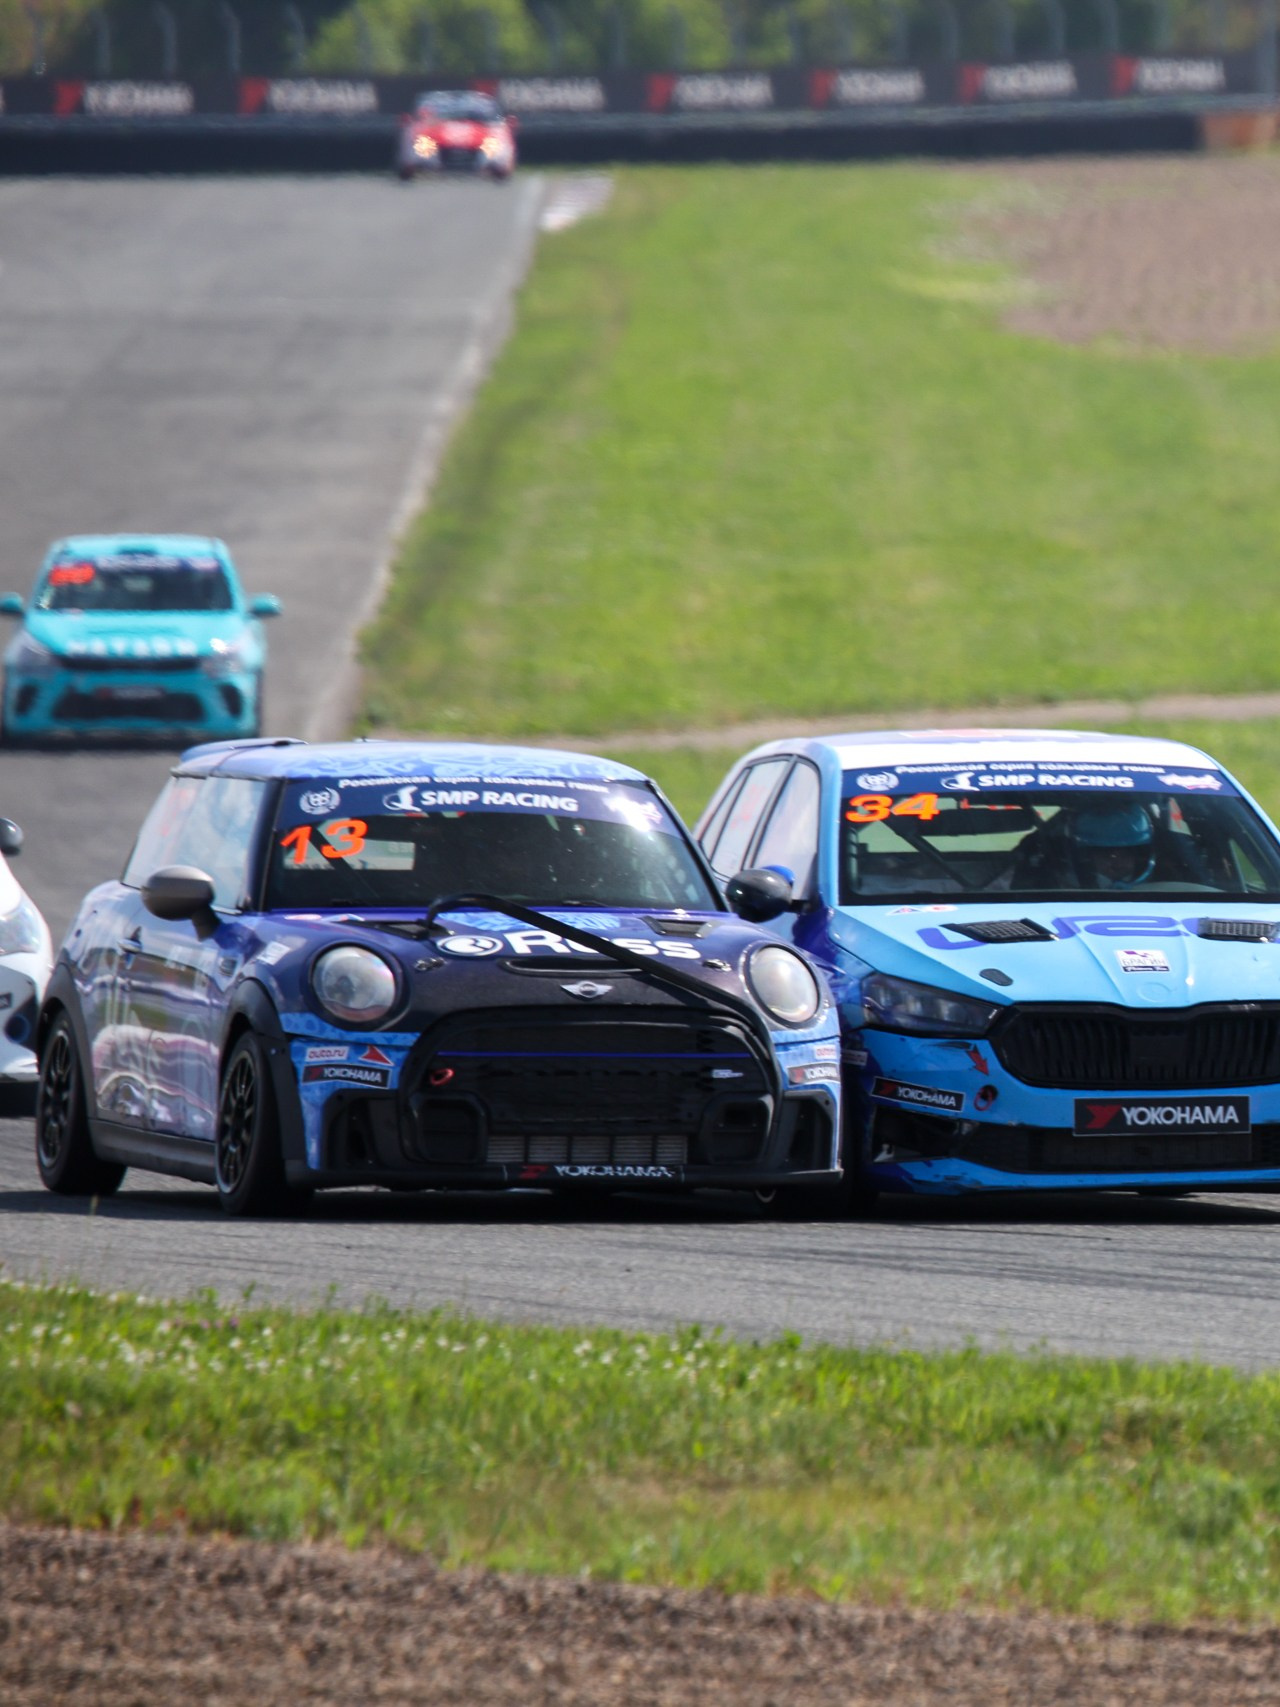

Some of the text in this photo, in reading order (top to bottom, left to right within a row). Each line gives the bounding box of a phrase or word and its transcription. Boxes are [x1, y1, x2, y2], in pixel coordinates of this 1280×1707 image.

[978, 773, 1134, 788] SMP RACING
[420, 790, 578, 812] SMP RACING
[845, 793, 940, 823] 34
[280, 818, 368, 864] 13
[323, 1067, 382, 1082] YOKOHAMA
[897, 1086, 956, 1107] YOKOHAMA
[1121, 1105, 1240, 1126] YOKOHAMA
[555, 1164, 676, 1178] YOKOHAMA
